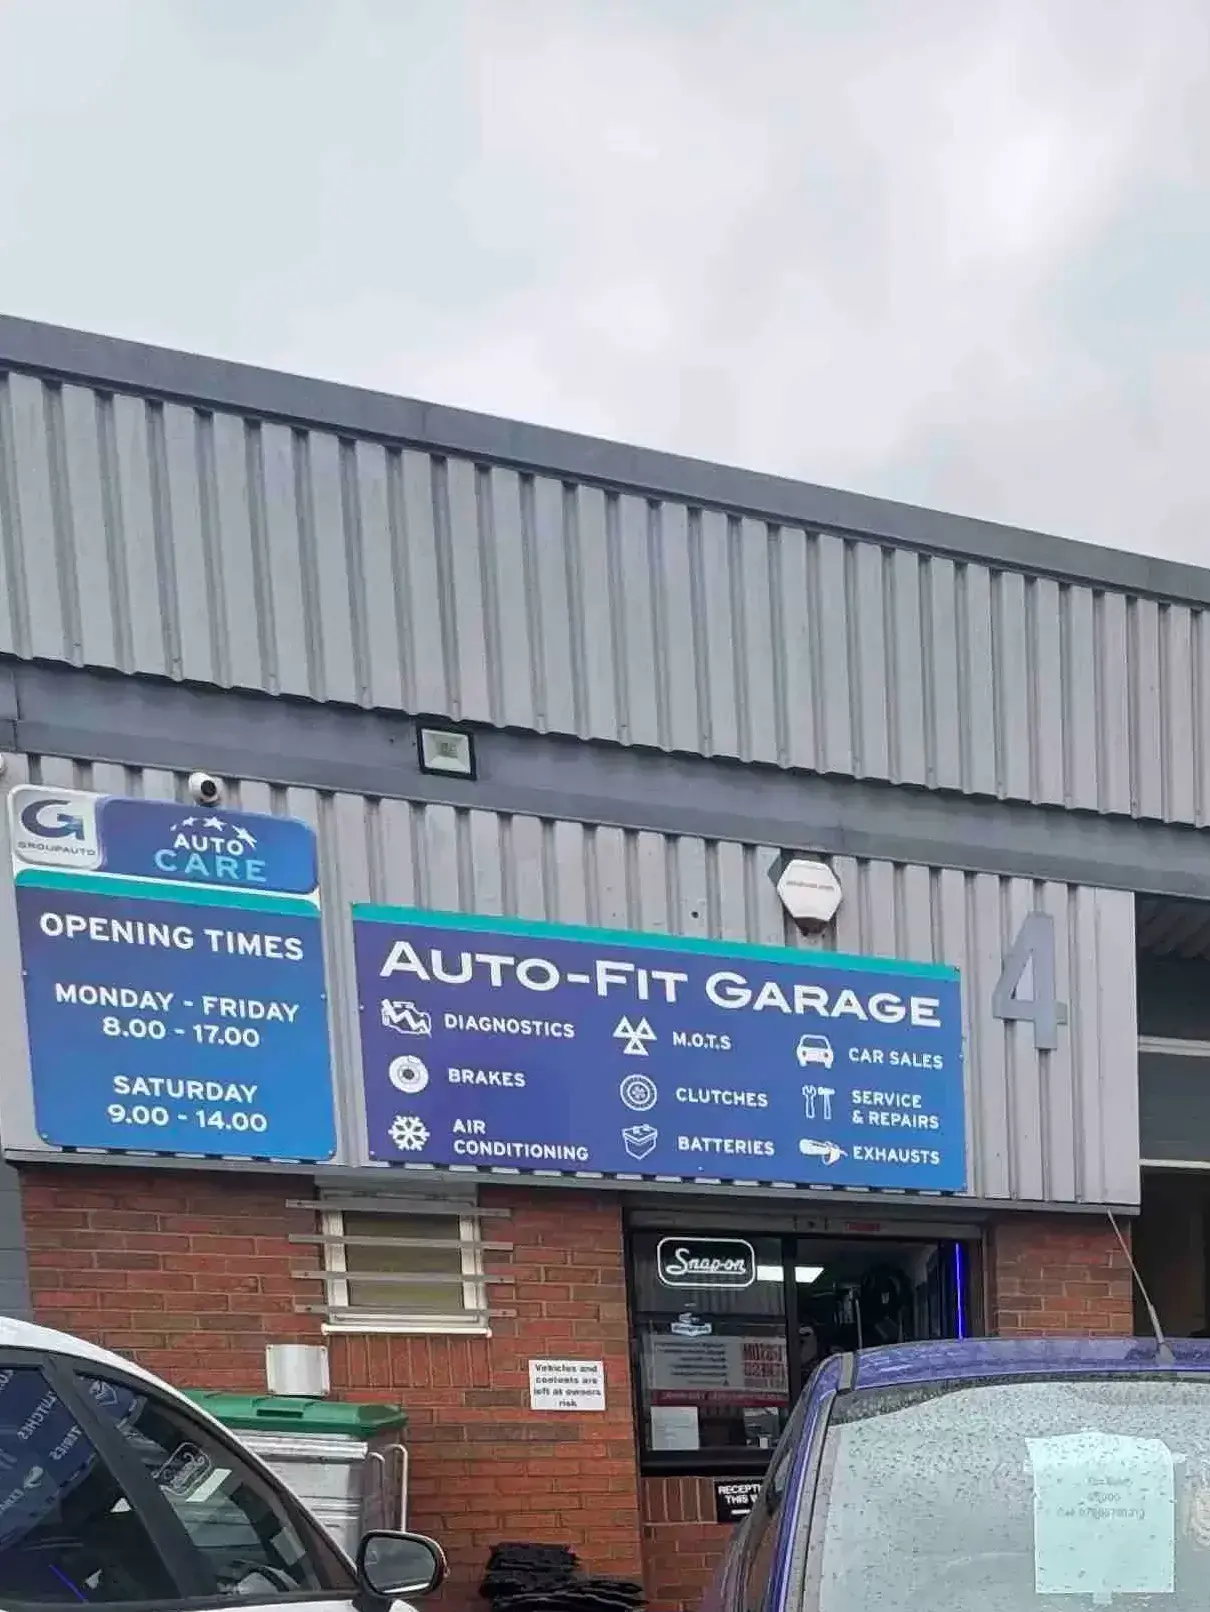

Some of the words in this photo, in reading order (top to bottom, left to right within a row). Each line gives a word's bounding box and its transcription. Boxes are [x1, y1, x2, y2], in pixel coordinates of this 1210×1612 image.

[18, 841, 96, 856] GROUPAUTO
[173, 832, 244, 856] AUTO
[153, 849, 267, 882] CARE
[40, 912, 194, 949] OPENING
[204, 928, 304, 960] TIMES
[379, 941, 688, 1003] AUTO-FIT
[705, 971, 941, 1028] GARAGE
[991, 910, 1068, 1051] 4
[55, 983, 174, 1011] MONDAY
[203, 997, 300, 1023] FRIDAY
[103, 1016, 166, 1040] 8.00
[193, 1025, 261, 1048] 17.00
[444, 1013, 575, 1039] DIAGNOSTICS
[849, 1047, 884, 1064] CAR
[889, 1051, 944, 1070] SALES
[112, 1075, 258, 1104] SATURDAY
[448, 1068, 526, 1088] BRAKES
[676, 1088, 768, 1108] CLUTCHES
[852, 1090, 922, 1109] SERVICE
[107, 1104, 169, 1127] 9.00
[196, 1110, 267, 1133] 14.00
[453, 1118, 487, 1135] AIR
[852, 1110, 864, 1125] &
[869, 1111, 940, 1130] REPAIRS
[453, 1140, 589, 1161] CONDITIONING
[678, 1136, 775, 1157] BATTERIES
[853, 1146, 941, 1165] EXHAUSTS
[665, 1247, 746, 1275] Snap-on
